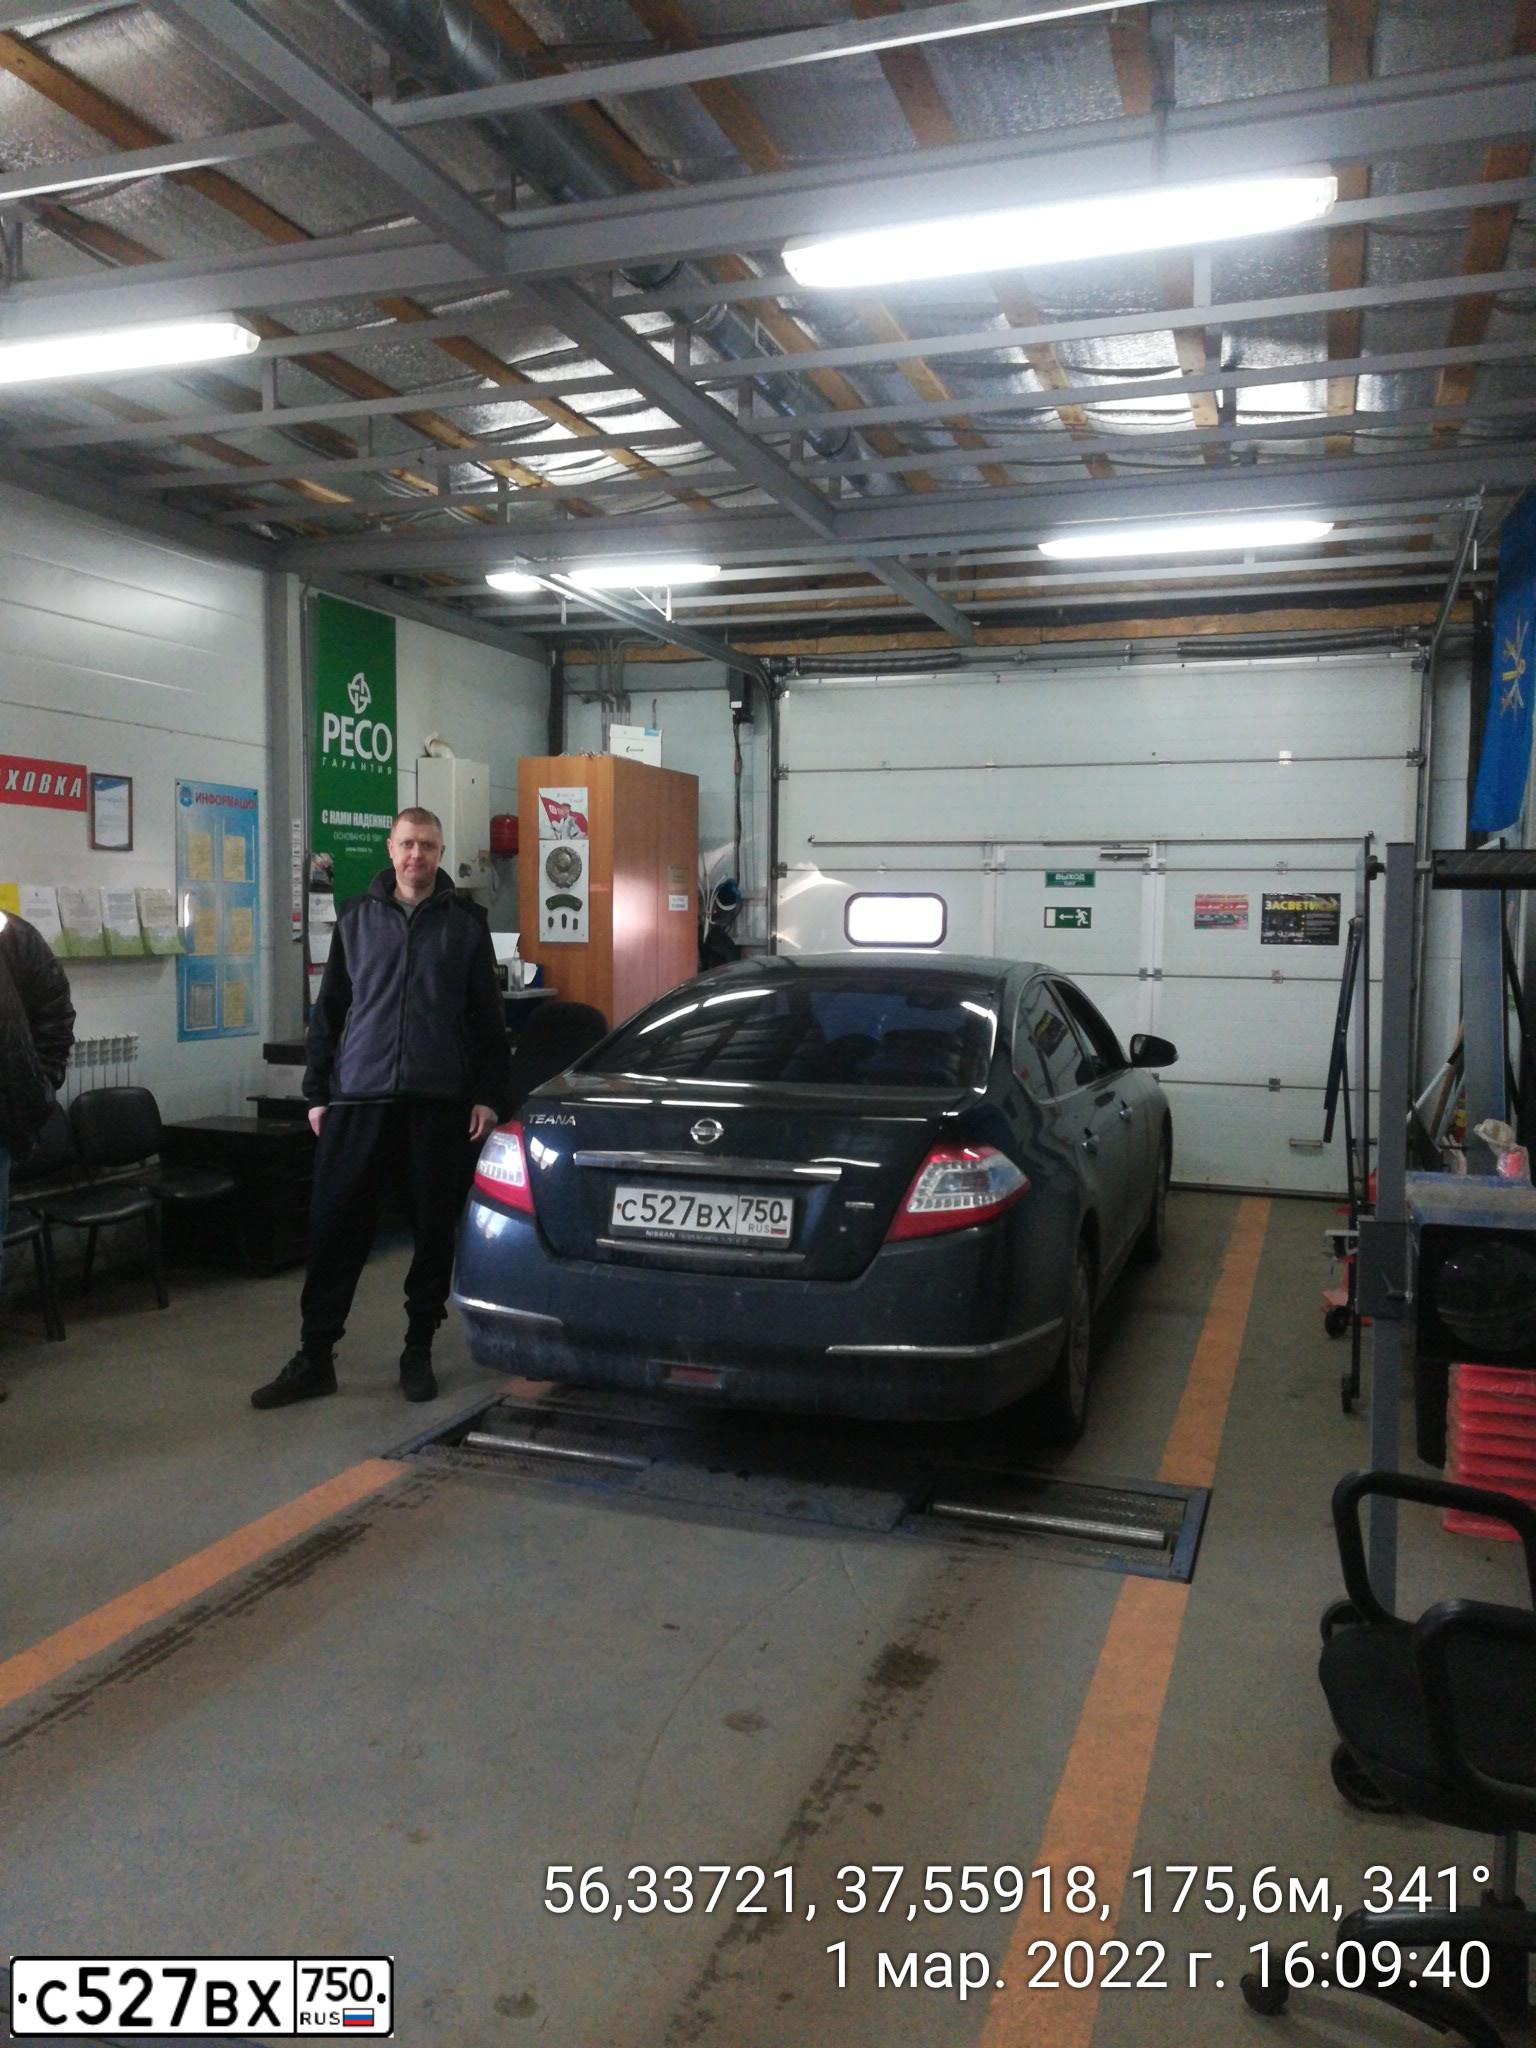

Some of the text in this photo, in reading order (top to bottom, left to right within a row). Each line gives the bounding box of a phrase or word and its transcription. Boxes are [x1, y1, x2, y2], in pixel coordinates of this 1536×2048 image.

[323, 712, 393, 763] РЕСО
[322, 756, 392, 775] ГАРАНТИЯ
[0, 768, 82, 798] ХОВКА
[321, 809, 329, 824] С
[329, 810, 352, 826] НАМИ
[528, 1114, 576, 1126] TEANA
[621, 1193, 784, 1229] С527ВХ 750
[645, 1229, 676, 1239] NISSAN
[749, 1223, 770, 1234] RUS
